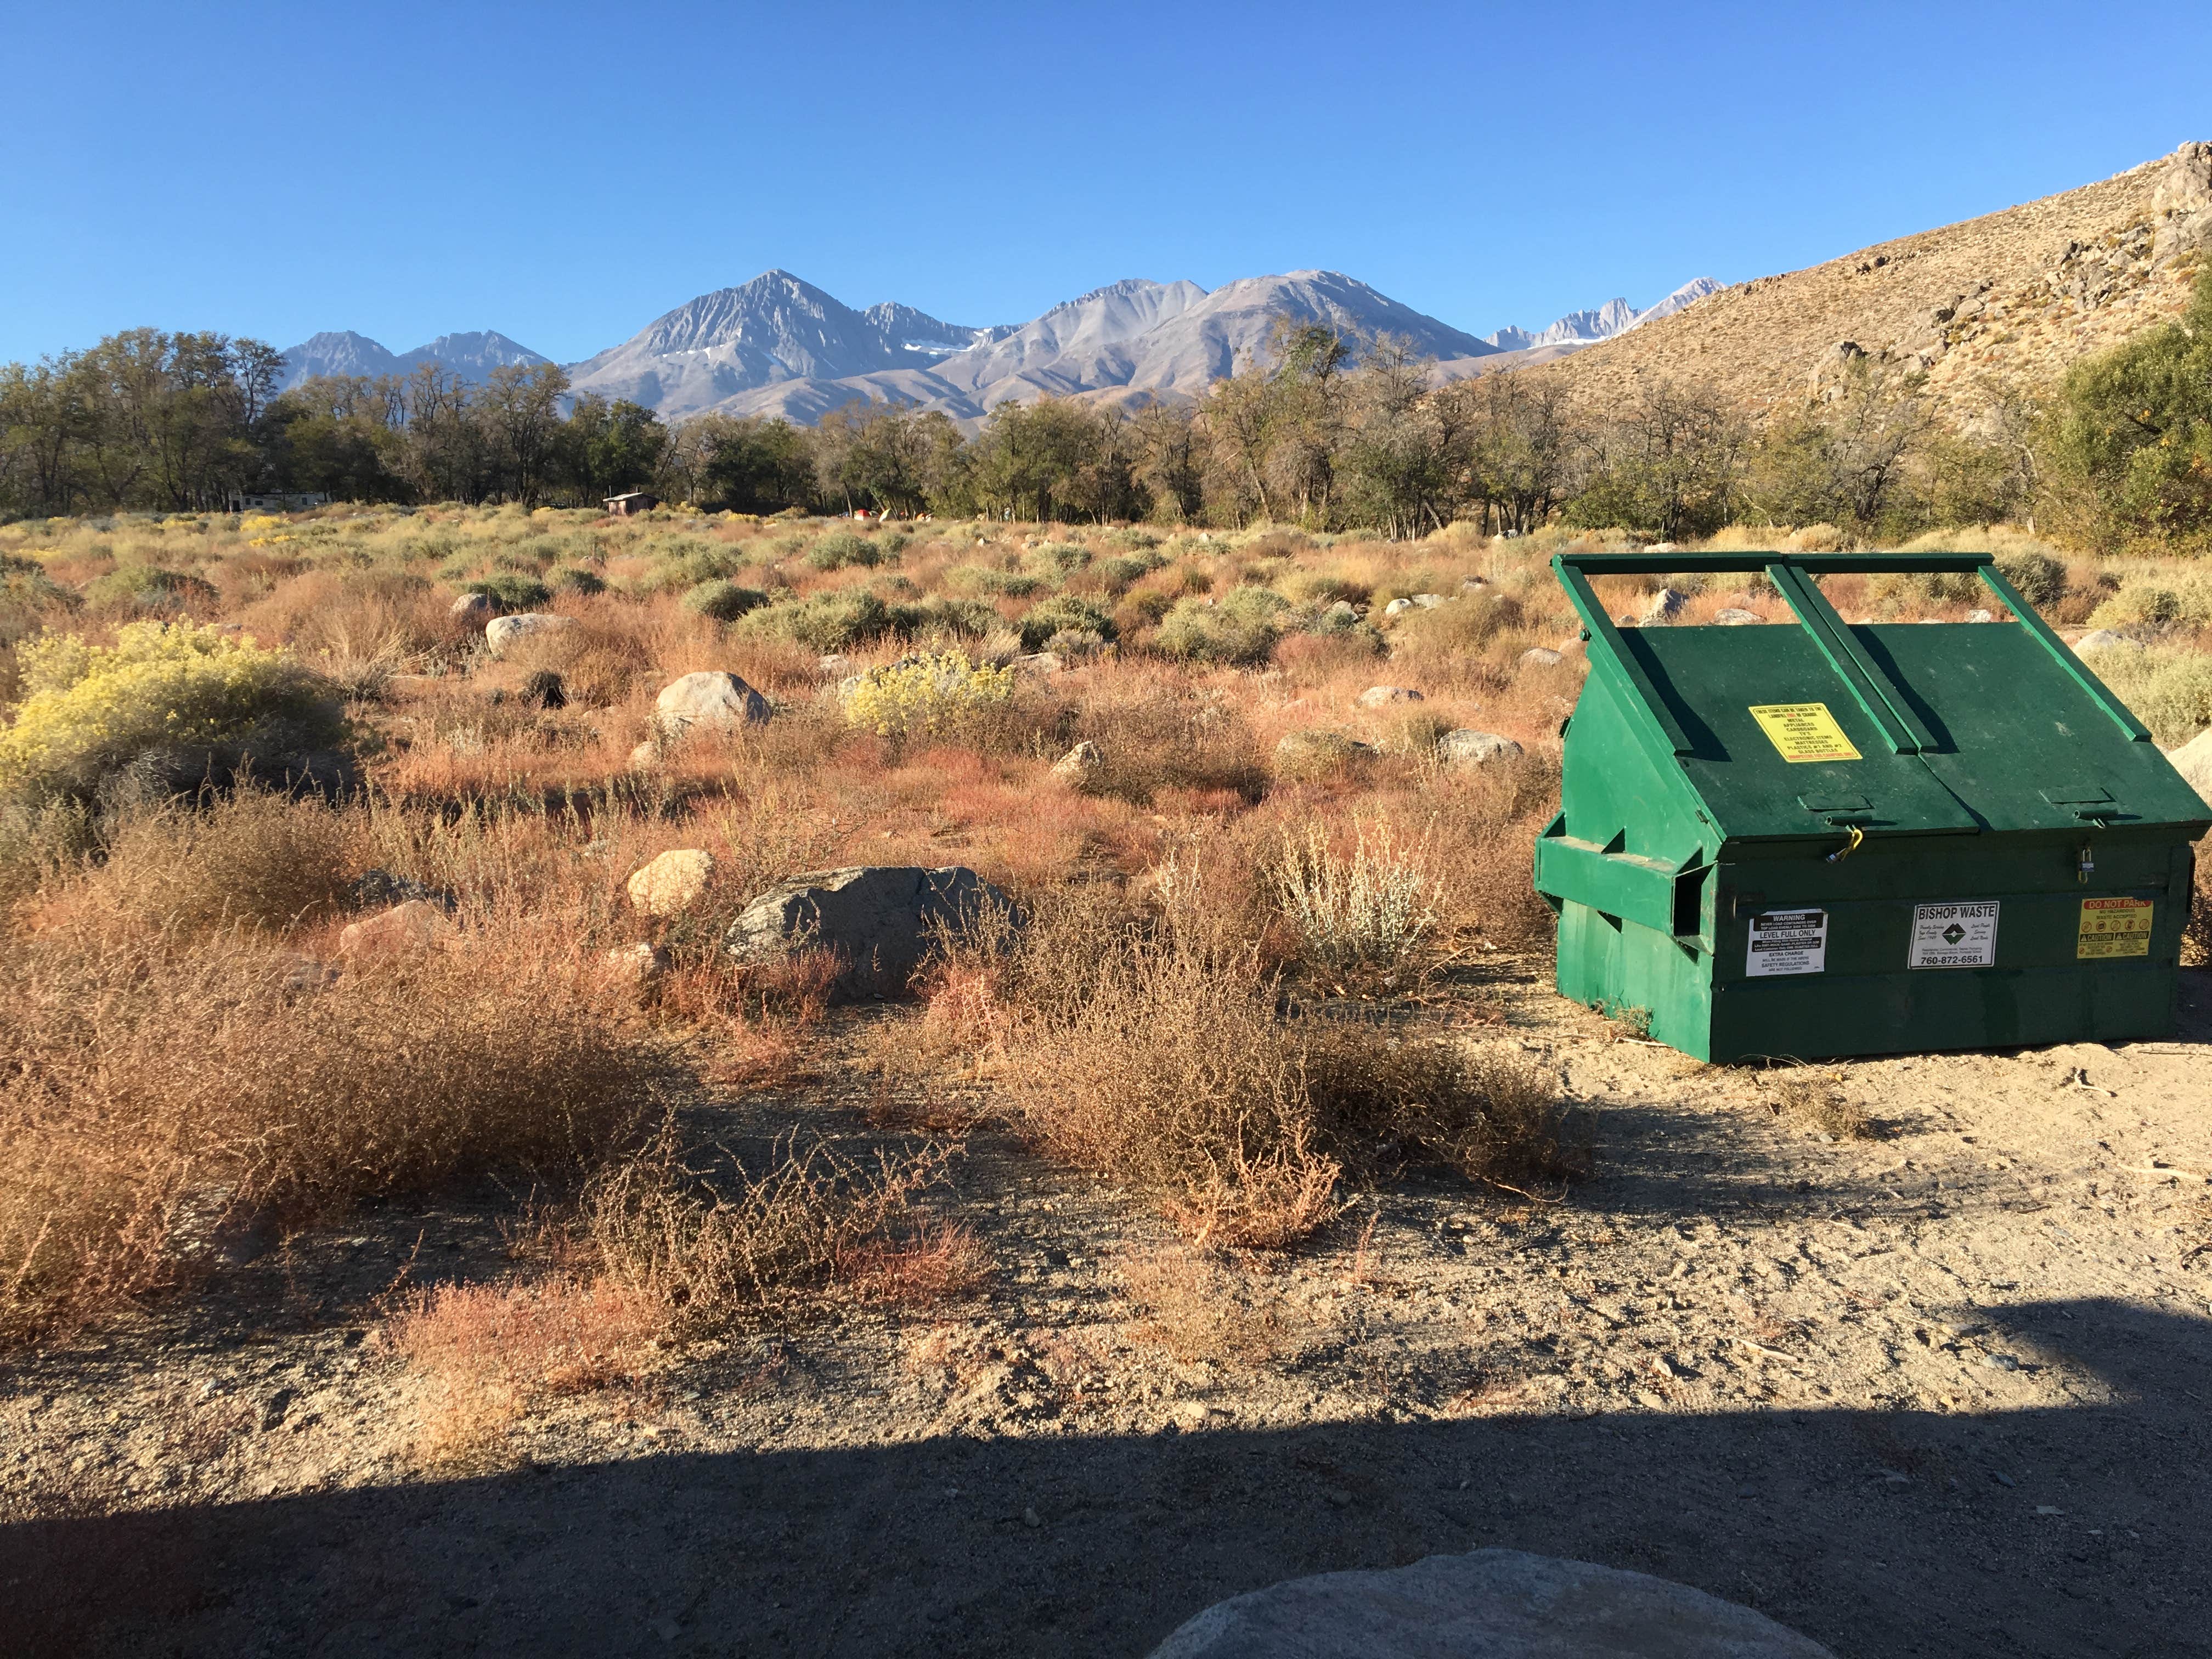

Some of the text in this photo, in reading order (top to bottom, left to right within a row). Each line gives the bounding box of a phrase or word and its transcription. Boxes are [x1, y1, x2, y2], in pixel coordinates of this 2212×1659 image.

[2104, 900, 2122, 908] NOT
[2123, 899, 2146, 907] PARK
[1918, 906, 1995, 919] BISHOP WASTE
[1798, 929, 1816, 937] ONLY
[2123, 932, 2147, 940] CAUTION
[1921, 955, 1983, 965] 760-872-6561
